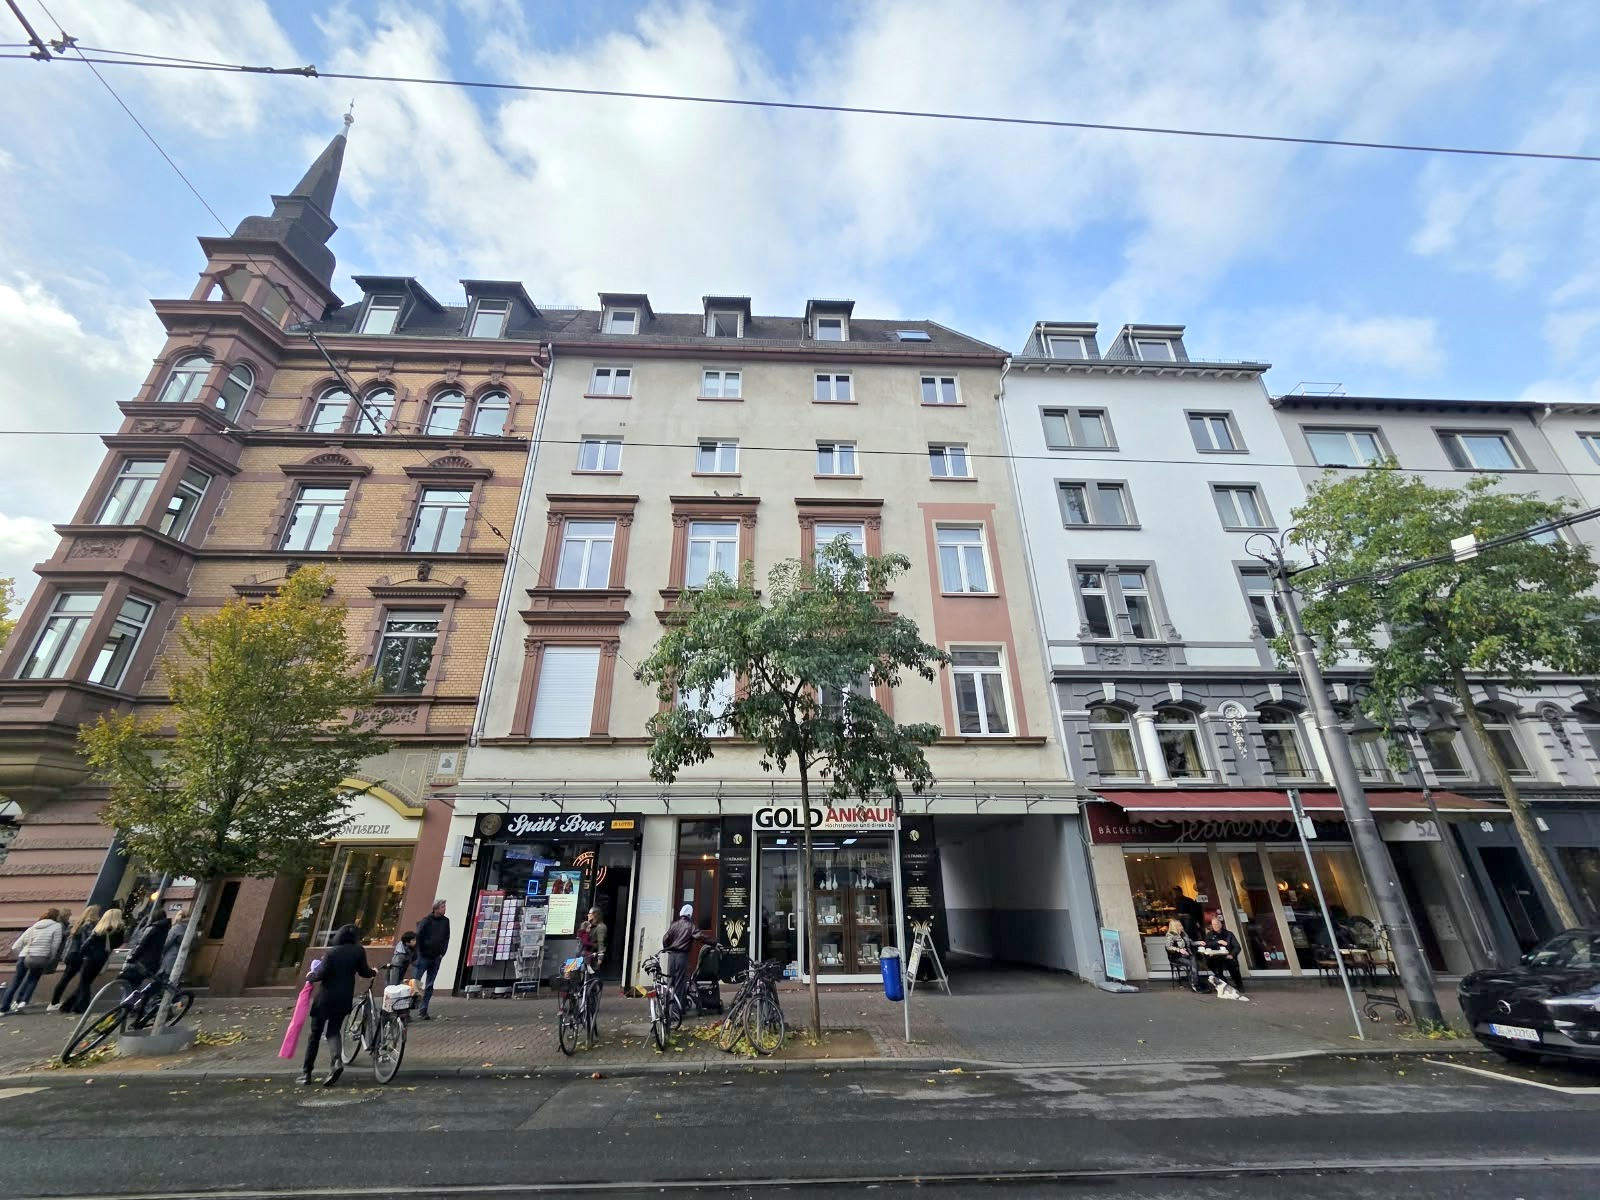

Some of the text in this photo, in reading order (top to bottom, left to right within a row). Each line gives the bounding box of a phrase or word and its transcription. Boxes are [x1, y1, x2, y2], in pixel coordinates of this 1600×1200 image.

[508, 813, 605, 836] Späti Bros
[755, 807, 823, 828] GOLD
[1480, 821, 1494, 832] 50
[1416, 820, 1437, 838] 52
